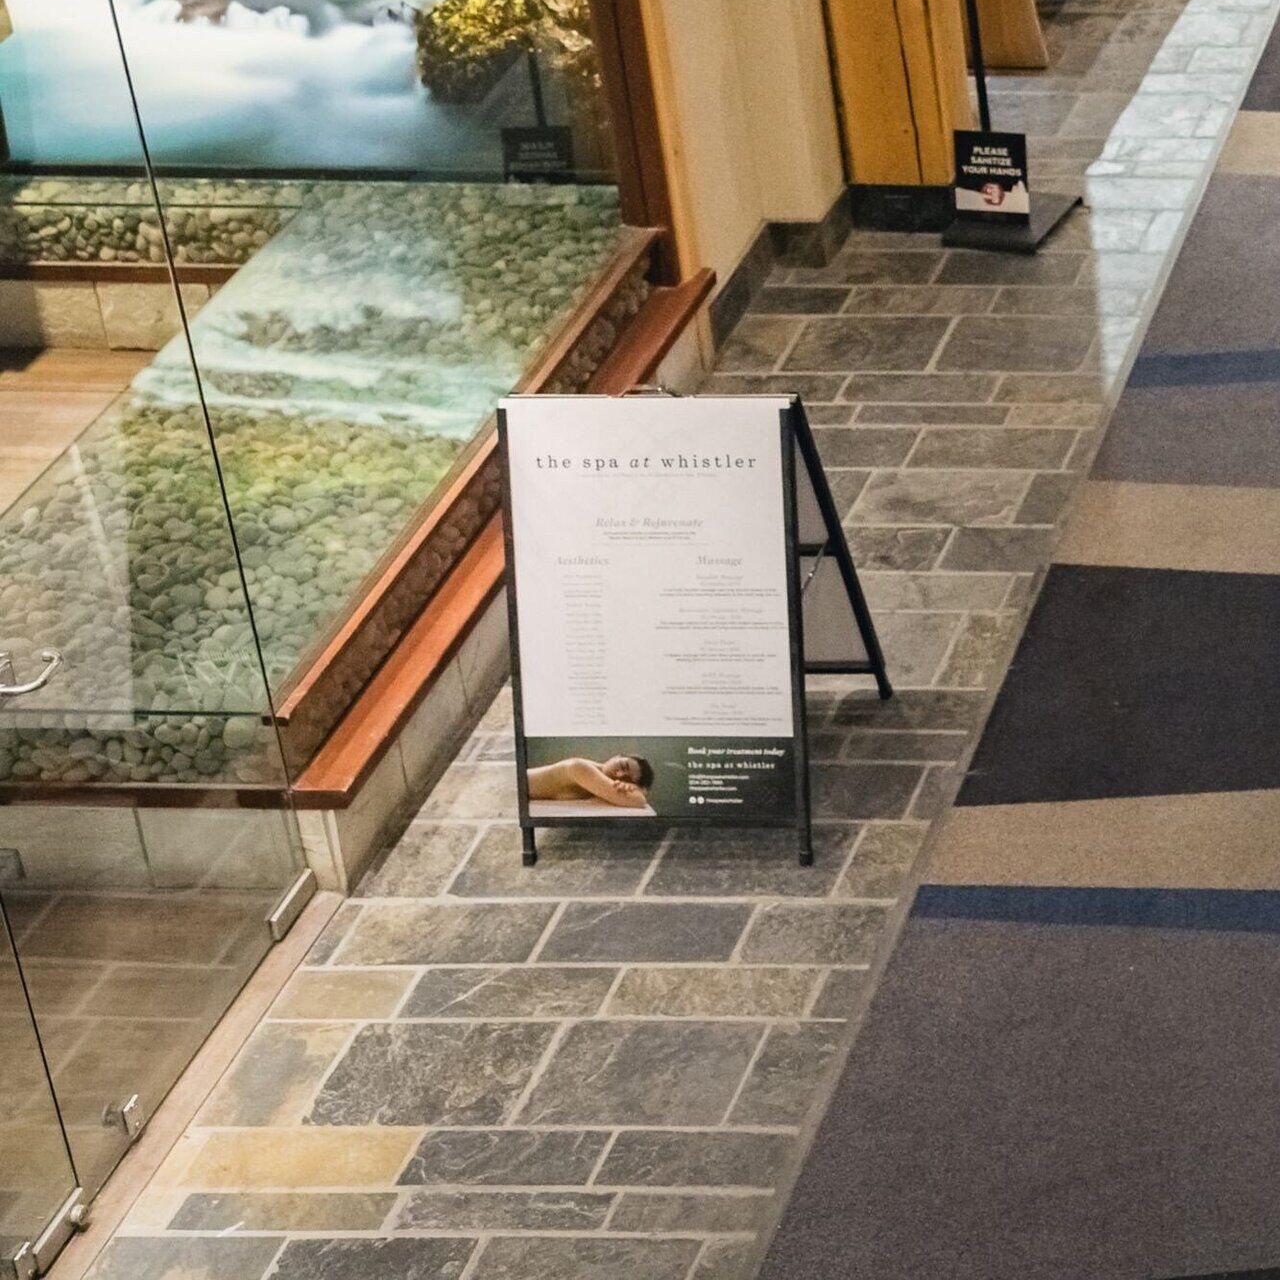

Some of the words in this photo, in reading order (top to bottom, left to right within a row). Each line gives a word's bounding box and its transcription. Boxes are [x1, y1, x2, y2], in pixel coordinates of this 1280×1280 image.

[973, 146, 1008, 156] PLEASE
[970, 156, 1012, 166] SANITIZE
[962, 165, 988, 174] YOUR
[990, 168, 1022, 177] HANDS
[536, 455, 571, 469] the
[583, 458, 619, 471] spa
[629, 456, 651, 469] at
[660, 454, 757, 469] whistler
